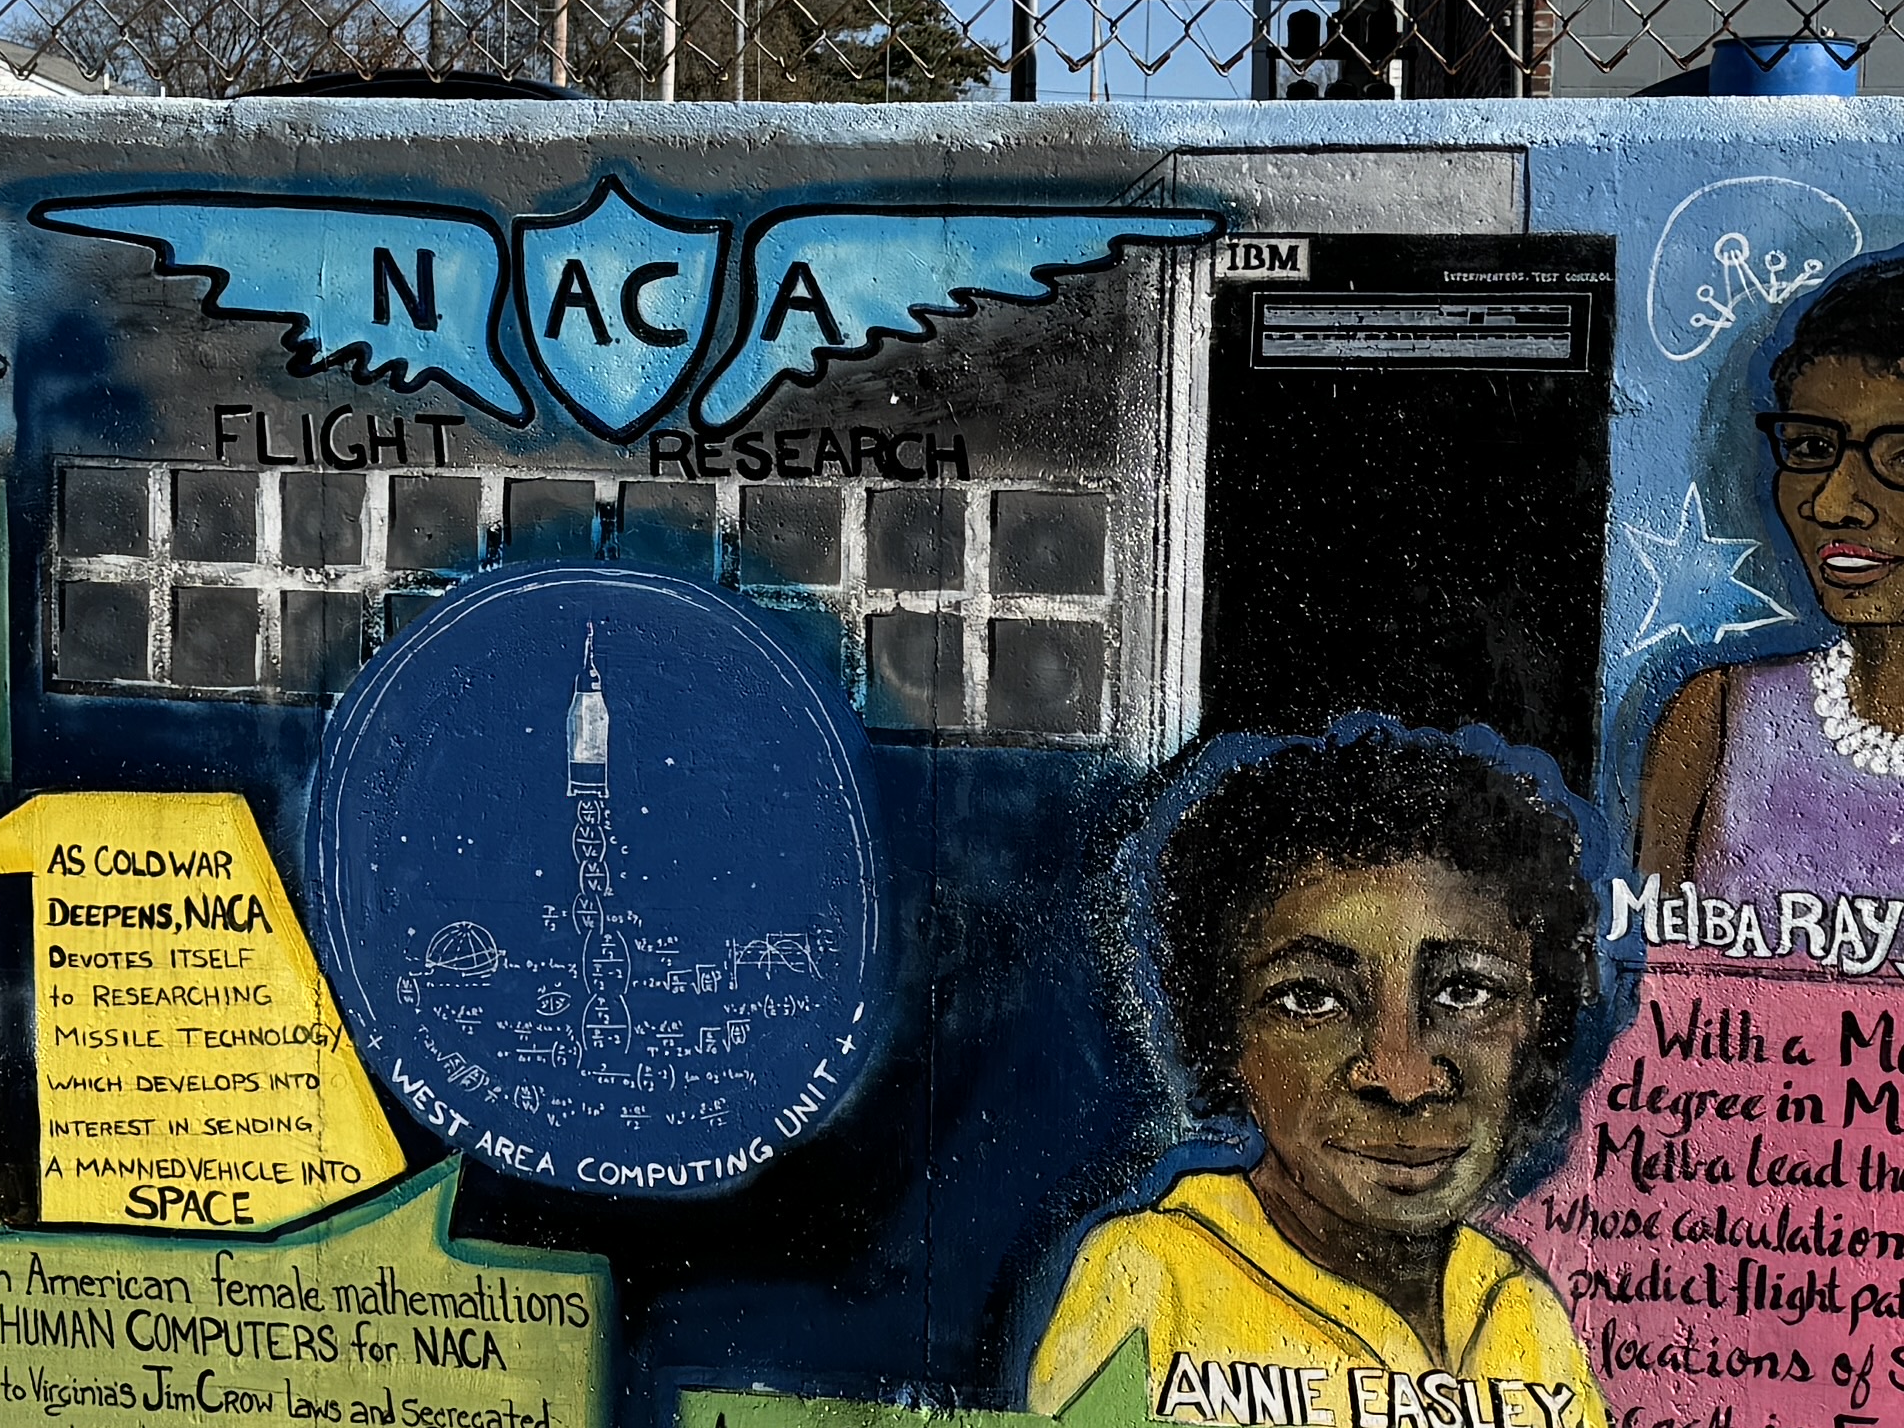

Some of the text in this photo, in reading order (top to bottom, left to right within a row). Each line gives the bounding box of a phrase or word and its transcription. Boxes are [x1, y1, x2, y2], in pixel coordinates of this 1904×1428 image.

[1226, 243, 1301, 271] IBM
[211, 403, 969, 482] FLIGHT RESEARCH
[47, 845, 232, 879] AS COLD WAR
[46, 895, 273, 935] DEEPENS, NACA
[1777, 889, 1903, 975] RAY
[49, 945, 255, 969] DEVOTES ITSELF
[93, 985, 272, 1007] RESEARCHING
[1650, 998, 1766, 1064] With
[1782, 1030, 1815, 1066] a
[391, 1058, 842, 1189] WEST AREA COMPUTING UNIT
[45, 1157, 361, 1185] A MANNED VEHICLE INTO
[124, 1185, 254, 1226] SPACE
[26, 1252, 192, 1304] American
[211, 1250, 324, 1311] female
[1155, 1351, 1338, 1427] ANNIE
